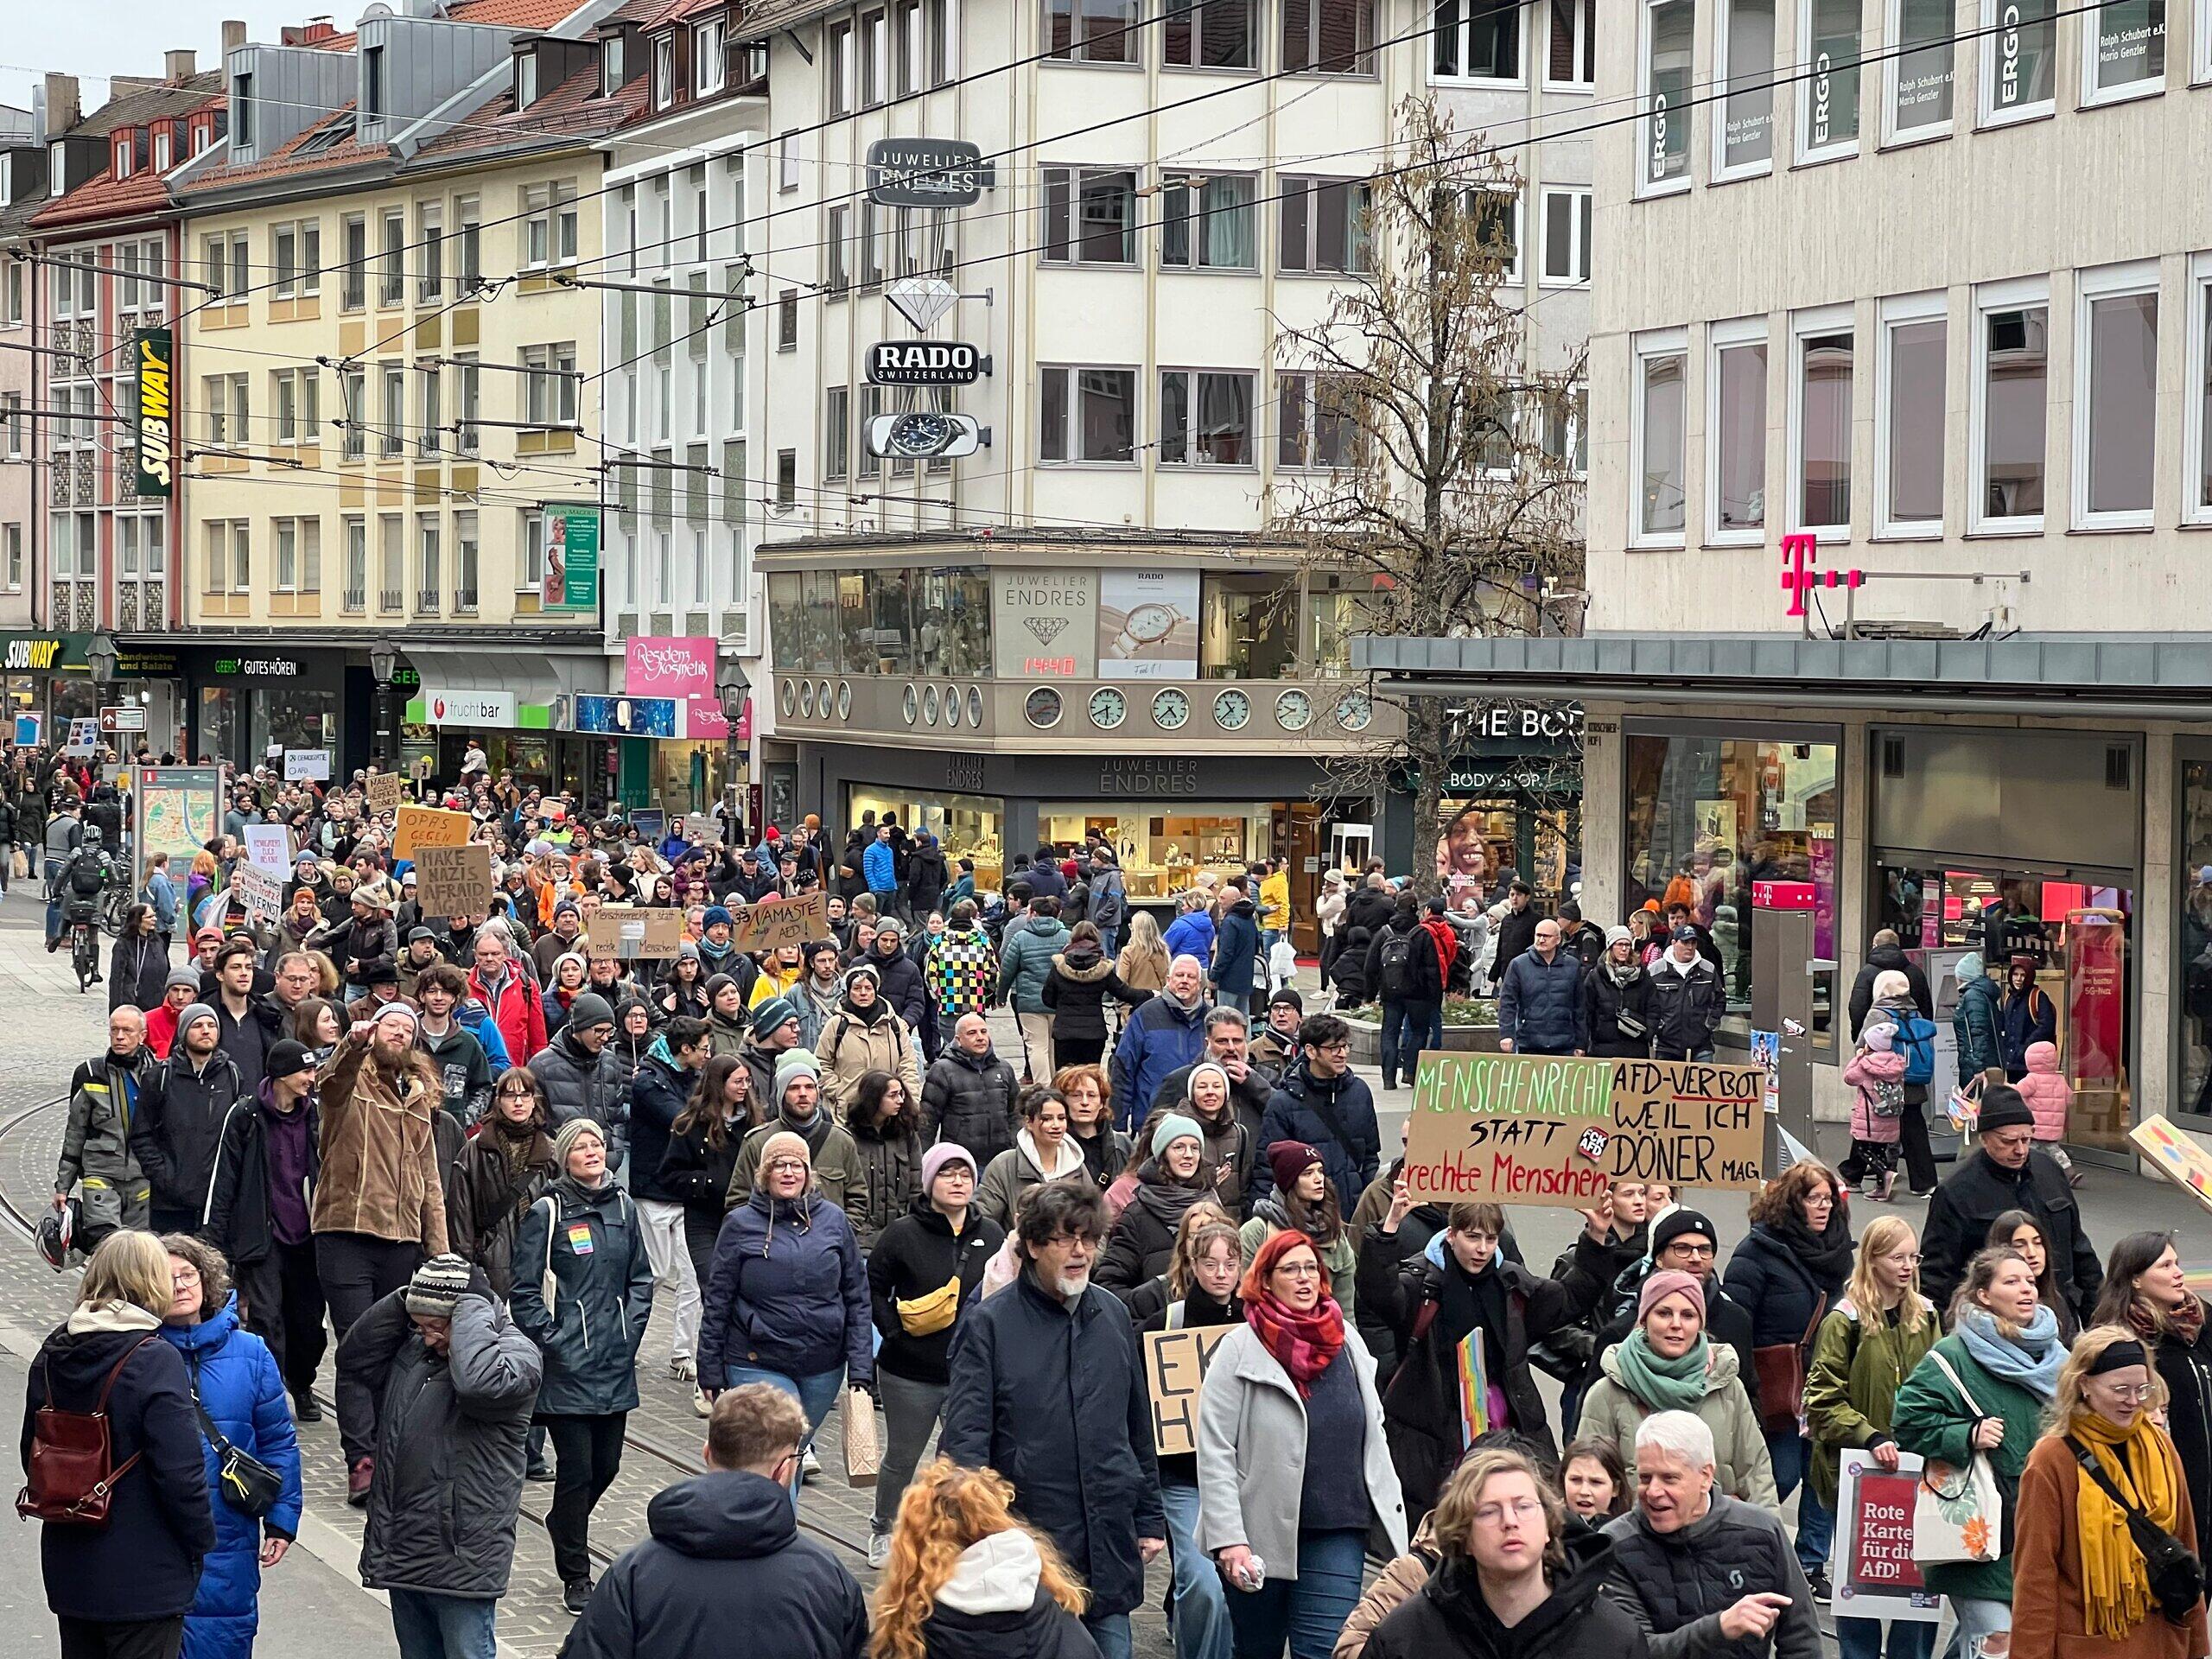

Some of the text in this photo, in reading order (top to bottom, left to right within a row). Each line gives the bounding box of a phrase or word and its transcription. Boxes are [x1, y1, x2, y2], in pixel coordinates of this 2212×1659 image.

[2100, 35, 2120, 48] Ralph
[2120, 26, 2152, 43] Schubart
[2001, 4, 2019, 104] ERGO
[2100, 44, 2147, 63] Mario Genzler
[1899, 81, 1916, 92] Ralph
[1917, 74, 1943, 88] Schubart
[1815, 52, 1831, 144] ERGO
[1898, 90, 1939, 107] Mario Genzler
[1742, 115, 1765, 129] Schubart
[1653, 93, 1667, 179] ERGO
[1742, 131, 1762, 143] Genzler
[880, 150, 974, 168] JUWELIER
[879, 169, 974, 193] ENES
[878, 346, 973, 369] RADO
[878, 371, 973, 379] SWITZERLAND
[139, 340, 171, 486] SUBWAY
[1007, 575, 1087, 586] JUWELIER
[1006, 589, 1086, 606] ENDRES
[4, 639, 60, 669] SUBWAY
[141, 662, 174, 671] Salate
[244, 659, 269, 675] GUTES
[269, 657, 296, 676] HÖREN
[1025, 657, 1076, 676] 14:40
[391, 670, 420, 684] GEE
[450, 701, 500, 718] fruchtbar
[1446, 709, 1509, 736] THE
[947, 755, 984, 769] JUWELIER
[1101, 760, 1198, 772] JUWELIER
[946, 769, 983, 790] ENDRES
[1100, 774, 1198, 793] ENDRES
[1451, 772, 1493, 787] BODY
[406, 814, 449, 830] OPAS
[410, 830, 451, 842] GEGEN
[422, 849, 466, 867] MAKE
[428, 866, 478, 883] NAZIS
[423, 882, 484, 899] AFRAID
[257, 896, 280, 917] ERNST
[432, 897, 485, 915] AGAIN
[594, 909, 675, 920] Menschenrechte statt
[748, 895, 820, 928] NAMASTÉ
[595, 939, 676, 952] rechte Menschen
[1613, 1062, 1764, 1098] AFD-VERBOT
[1614, 1101, 1691, 1131] WEIL
[1706, 1102, 1751, 1131] ICH
[1467, 1118, 1567, 1149] STATT
[1583, 1128, 1607, 1147] FCK
[1580, 1137, 1603, 1156] AFD
[1610, 1130, 1760, 1182] DÖNER MAG
[1408, 1149, 1609, 1198] rechte Menschen
[1864, 1503, 1905, 1521] Rote
[1862, 1522, 1913, 1540] Karte
[1861, 1541, 1890, 1559] für
[1859, 1561, 1901, 1580] AfD!
